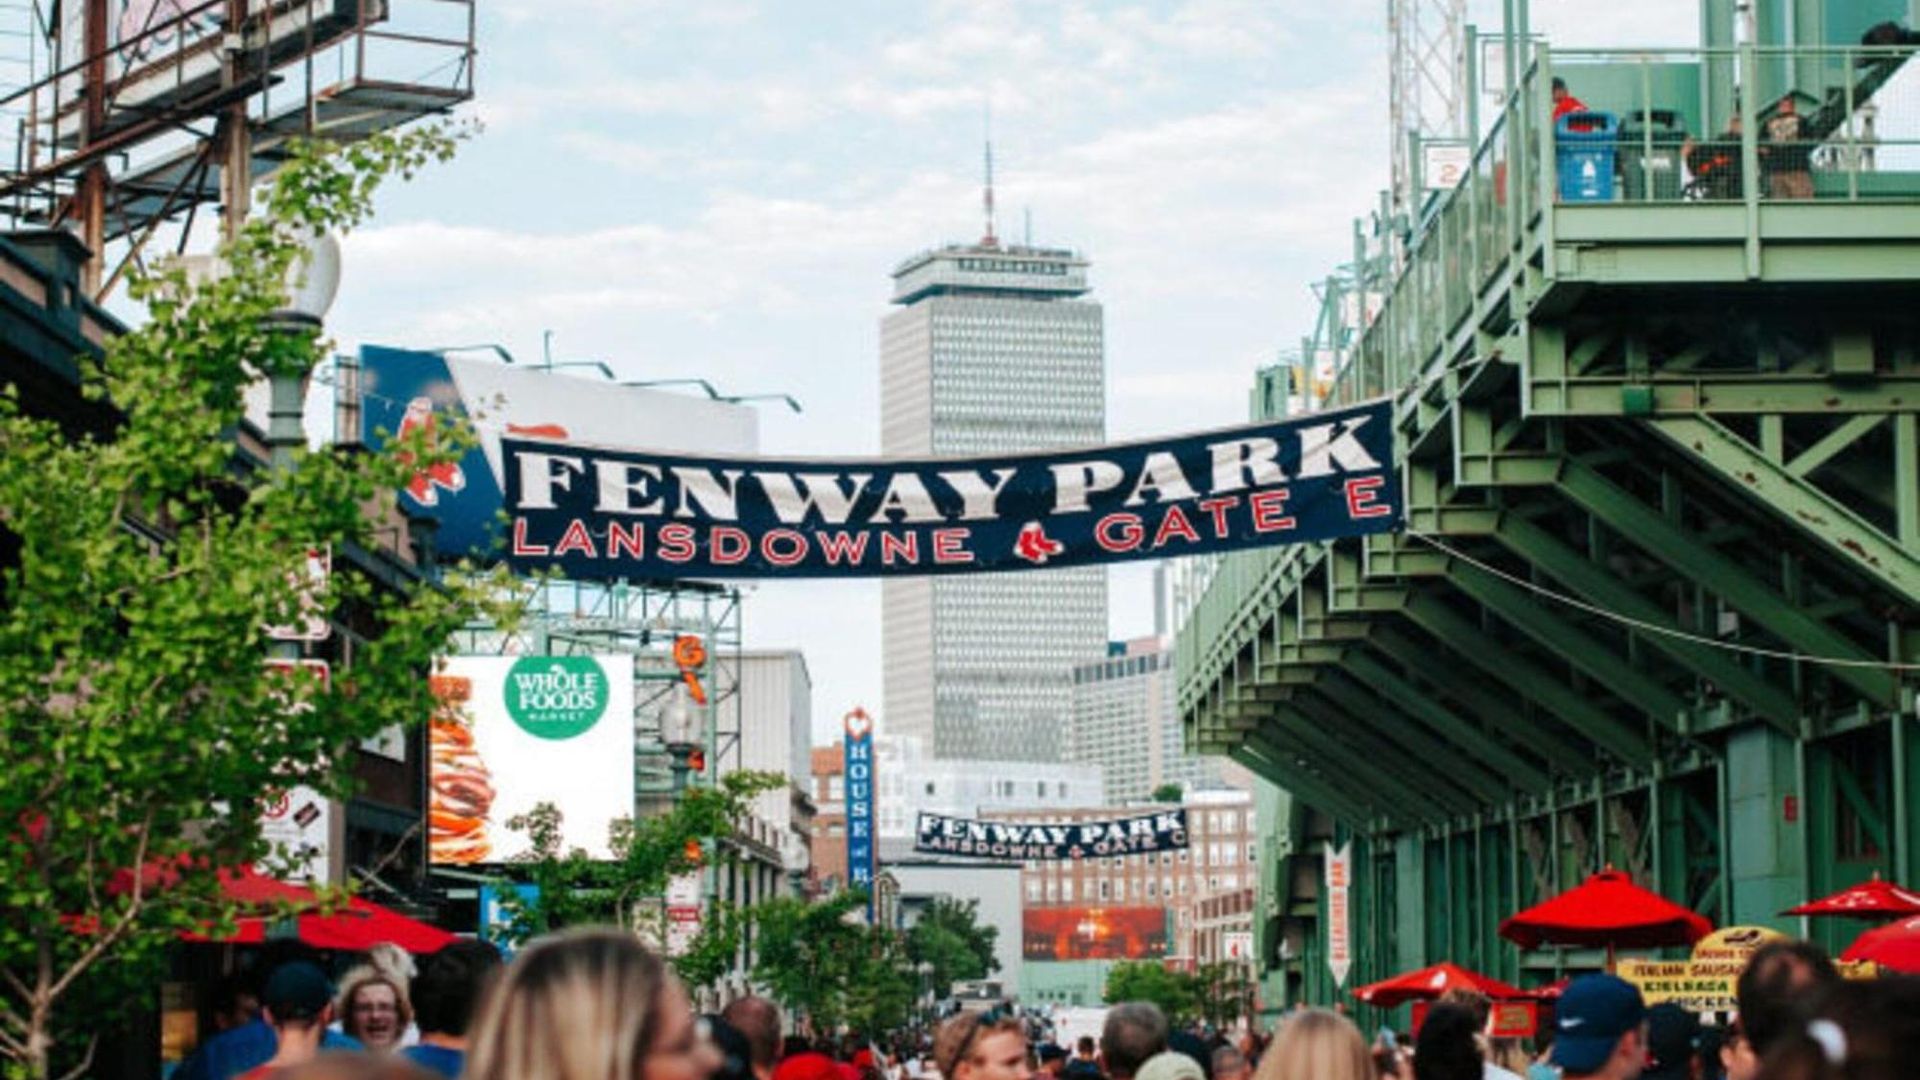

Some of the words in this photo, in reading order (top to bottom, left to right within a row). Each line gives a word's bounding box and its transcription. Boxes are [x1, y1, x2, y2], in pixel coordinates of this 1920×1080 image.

[514, 450, 1017, 524] FENWAY
[1048, 414, 1383, 515] PARK
[513, 516, 974, 567] LANSDOWNE
[1095, 489, 1296, 552] GATE
[1344, 475, 1391, 519] E
[514, 667, 600, 690] WHOLE
[520, 690, 597, 710] FOODS
[849, 744, 869, 837] HOUSE
[920, 814, 1070, 846] FENWAY
[1080, 812, 1182, 844] PARK
[916, 833, 1058, 859] LANSDOWNE
[1644, 981, 1728, 992] KIELBASA
